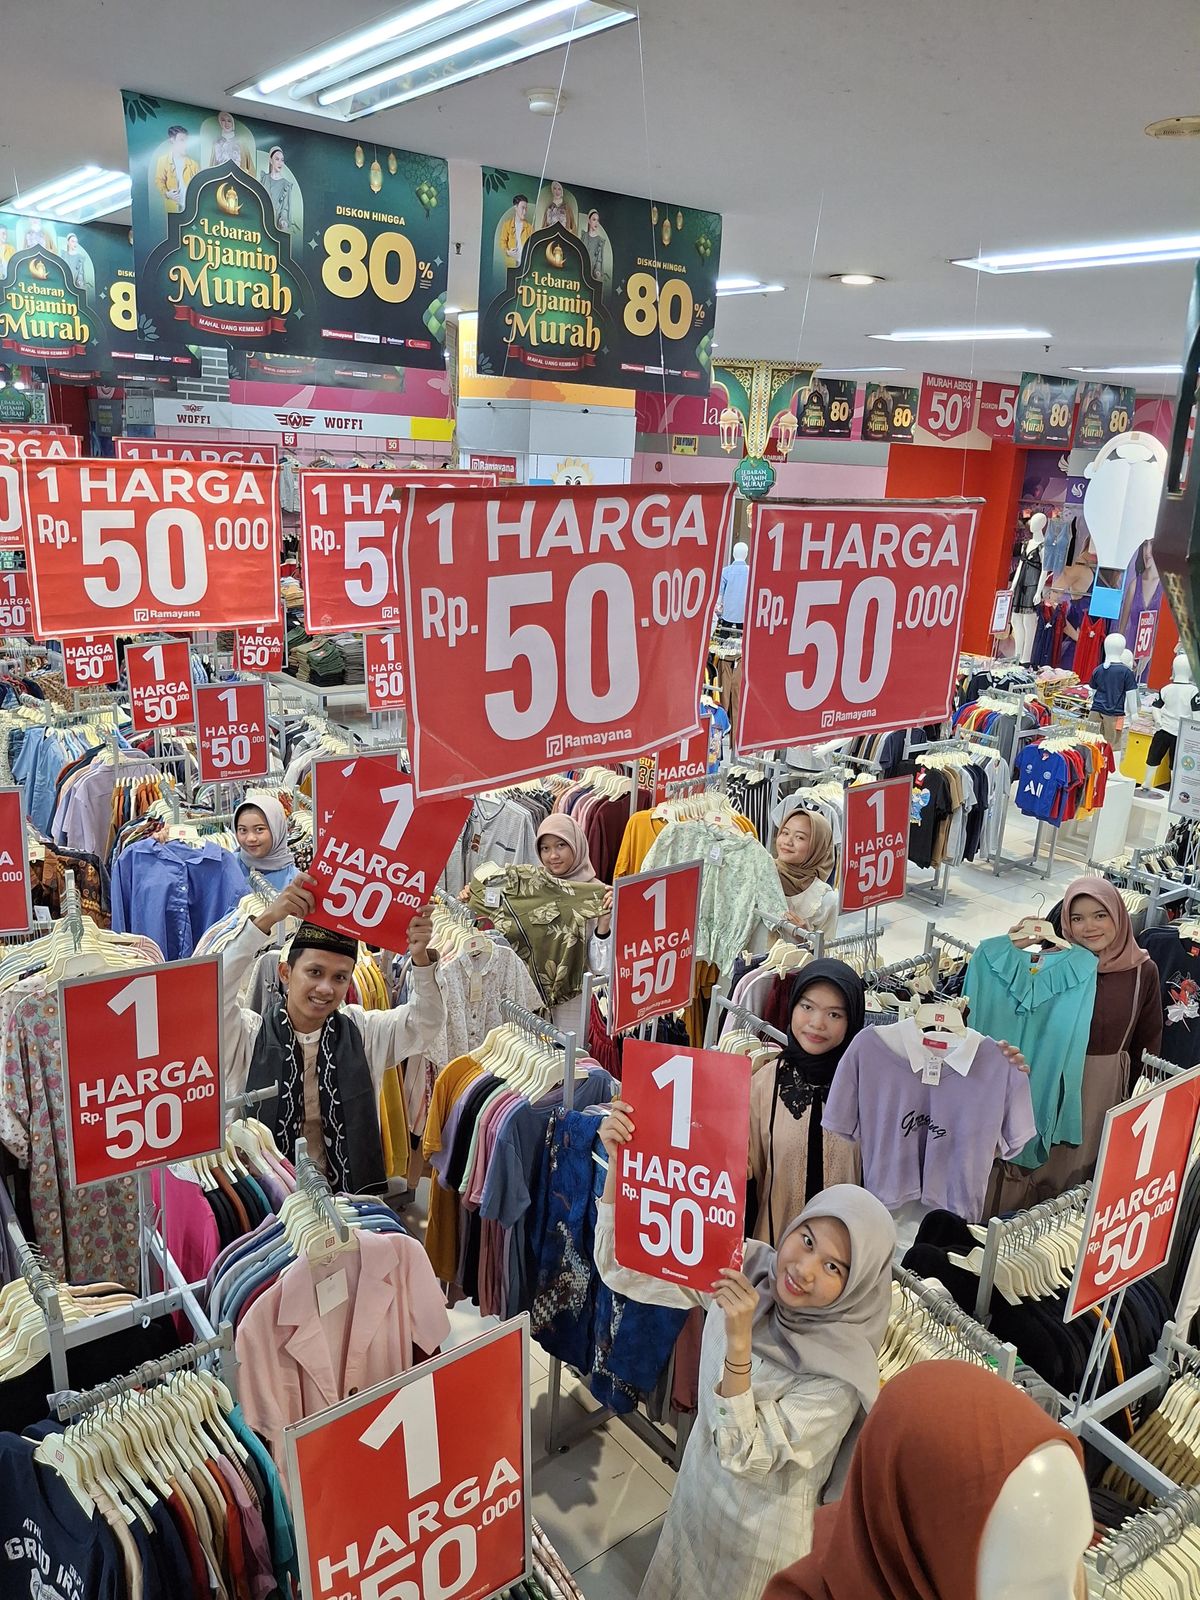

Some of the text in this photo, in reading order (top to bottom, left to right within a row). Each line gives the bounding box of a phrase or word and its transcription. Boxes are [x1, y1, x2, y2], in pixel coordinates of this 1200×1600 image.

[200, 219, 261, 244] Lebaran
[336, 206, 406, 226] DISKON HINGGA
[183, 234, 277, 273] Dijamin
[637, 257, 686, 274] DISKON HINGGA
[18, 282, 64, 298] Lebaran
[168, 265, 292, 314] Murah
[532, 272, 580, 292] Lebaran
[6, 292, 77, 316] Dijamin
[518, 286, 592, 318] Dijamin
[0, 311, 90, 344] Murah
[199, 317, 264, 335] MAHAL UANG KEMBALI
[503, 311, 601, 351] Murah
[526, 355, 545, 366] MAHAL
[927, 376, 953, 389] MURAH
[177, 414, 211, 425] WOFFI
[324, 417, 363, 431] WOFFI
[480, 461, 515, 473] Ramayana
[37, 467, 265, 504] 1 HARGA
[311, 483, 328, 515] 1
[37, 514, 78, 549] Rp.
[310, 525, 341, 556] Rp.
[426, 502, 455, 564] 1
[487, 494, 708, 562] HARGA
[767, 522, 960, 572] 1 HARGA
[3, 574, 17, 597] 1
[150, 609, 201, 620] Ramayana
[421, 587, 479, 648] Rp.
[756, 588, 788, 636] Rp.
[66, 643, 113, 658] HARGA
[238, 635, 281, 646] HARGA
[380, 634, 395, 661] 1
[142, 645, 166, 681] 1
[372, 662, 402, 673] HARG
[133, 681, 189, 699] HARGA
[217, 688, 239, 722] 1
[205, 722, 260, 737] HARGA
[835, 709, 877, 722] Ramayana
[565, 729, 633, 748] Ramayana
[657, 762, 706, 781] HARGA
[379, 782, 415, 851] 1
[866, 789, 885, 834] 1
[855, 832, 904, 855] HARGA
[317, 860, 334, 877] Rp.
[322, 836, 426, 894] HARGA
[642, 878, 667, 932] 1
[624, 927, 691, 961] HARGA
[106, 974, 160, 1060] 1
[78, 1056, 215, 1109] HARGA
[651, 1055, 694, 1150] 1
[80, 1111, 103, 1126] Rp.
[1131, 1091, 1167, 1181] 1
[622, 1149, 736, 1204] HARGA
[622, 1182, 639, 1200] Rp.
[1090, 1170, 1176, 1238] HARGA
[358, 1372, 442, 1500] 1
[317, 1457, 521, 1592] HARGA
[4, 1537, 51, 1576] GRID
